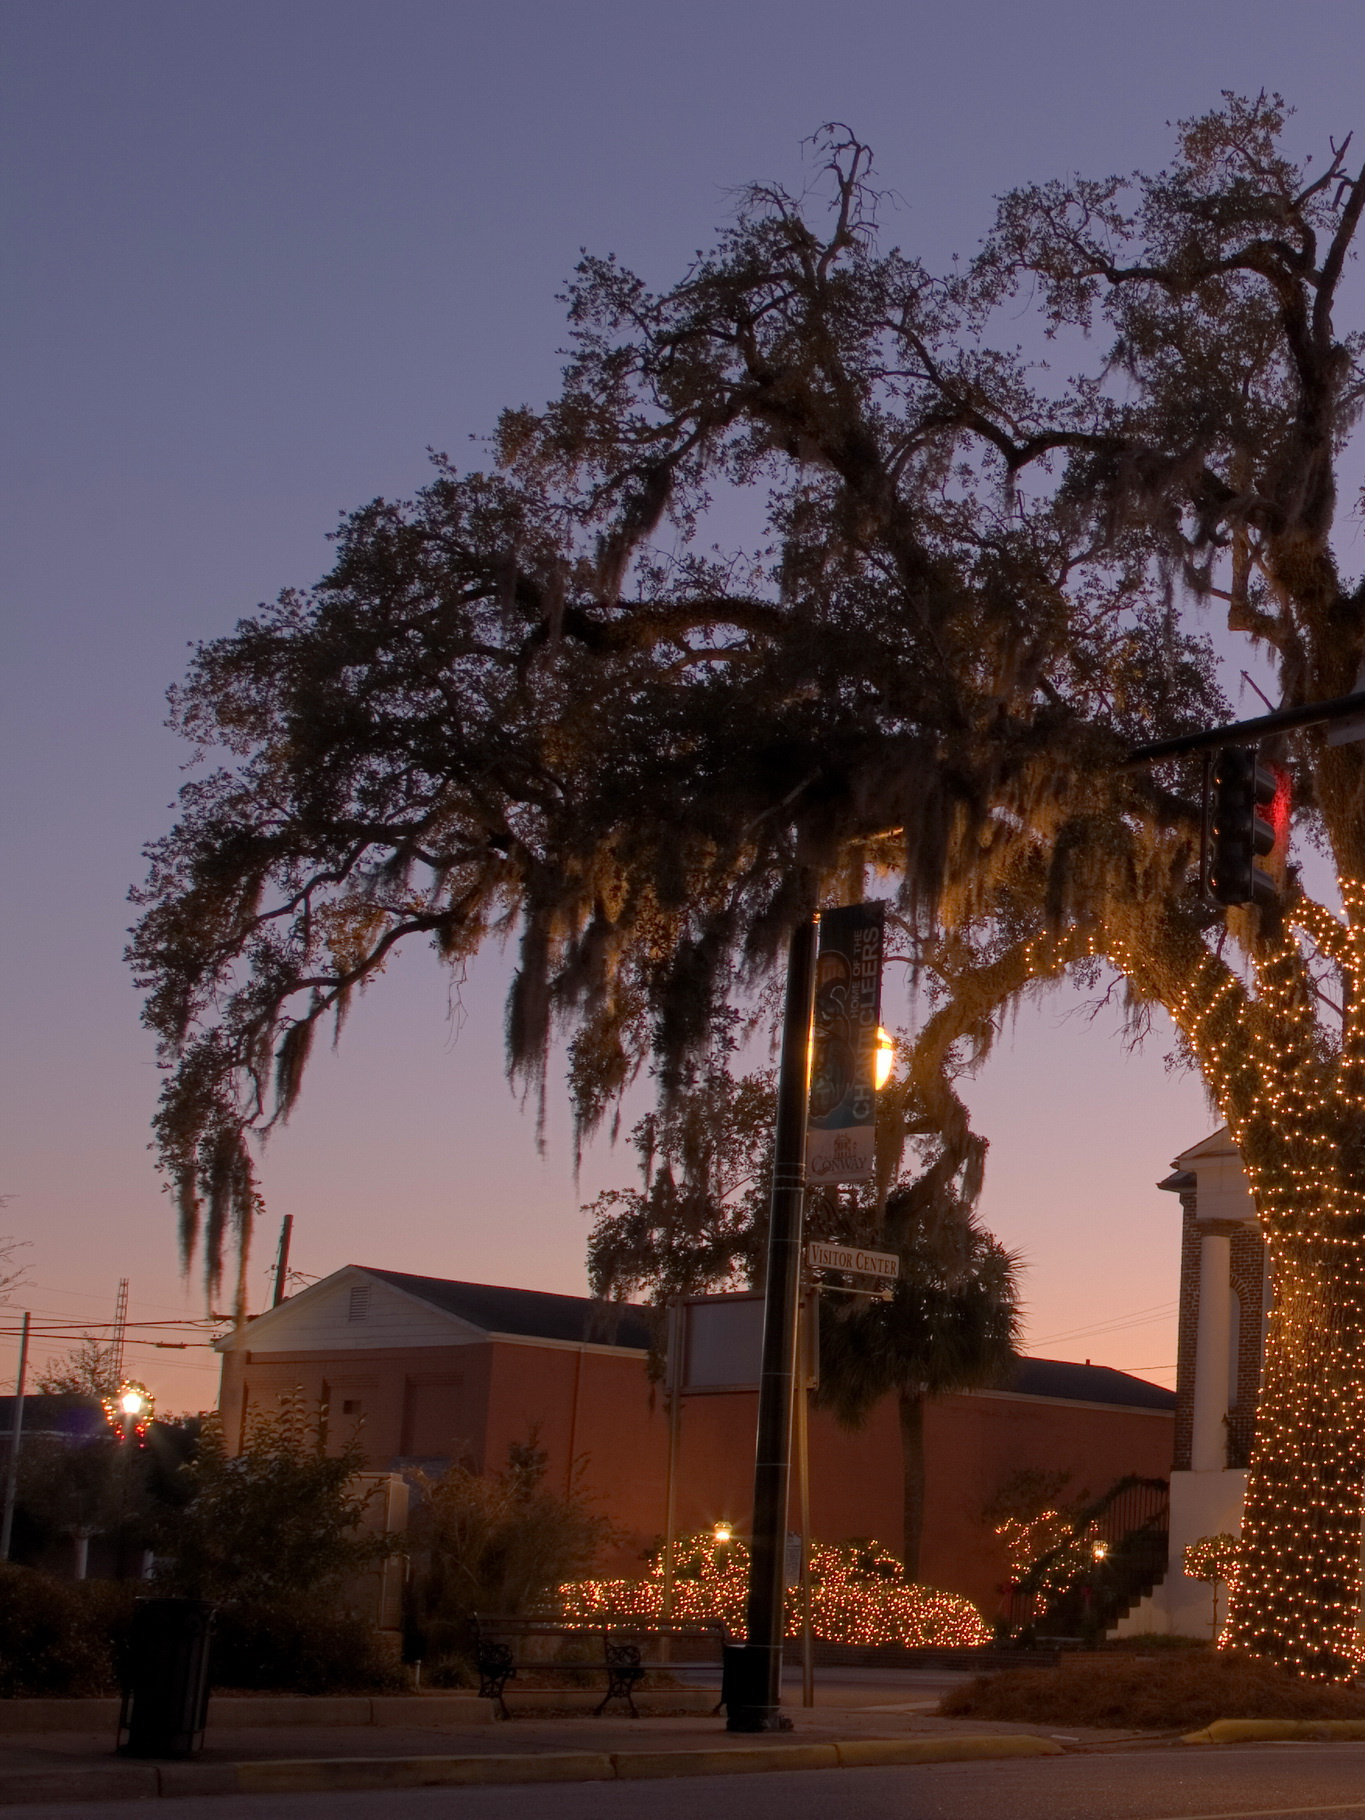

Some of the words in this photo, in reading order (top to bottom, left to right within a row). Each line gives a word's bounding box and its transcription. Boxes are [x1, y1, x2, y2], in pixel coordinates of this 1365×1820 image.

[853, 929, 862, 956] THE
[852, 959, 861, 977] OF
[850, 981, 861, 1019] HOME
[852, 926, 879, 1120] CHANTICLEERS
